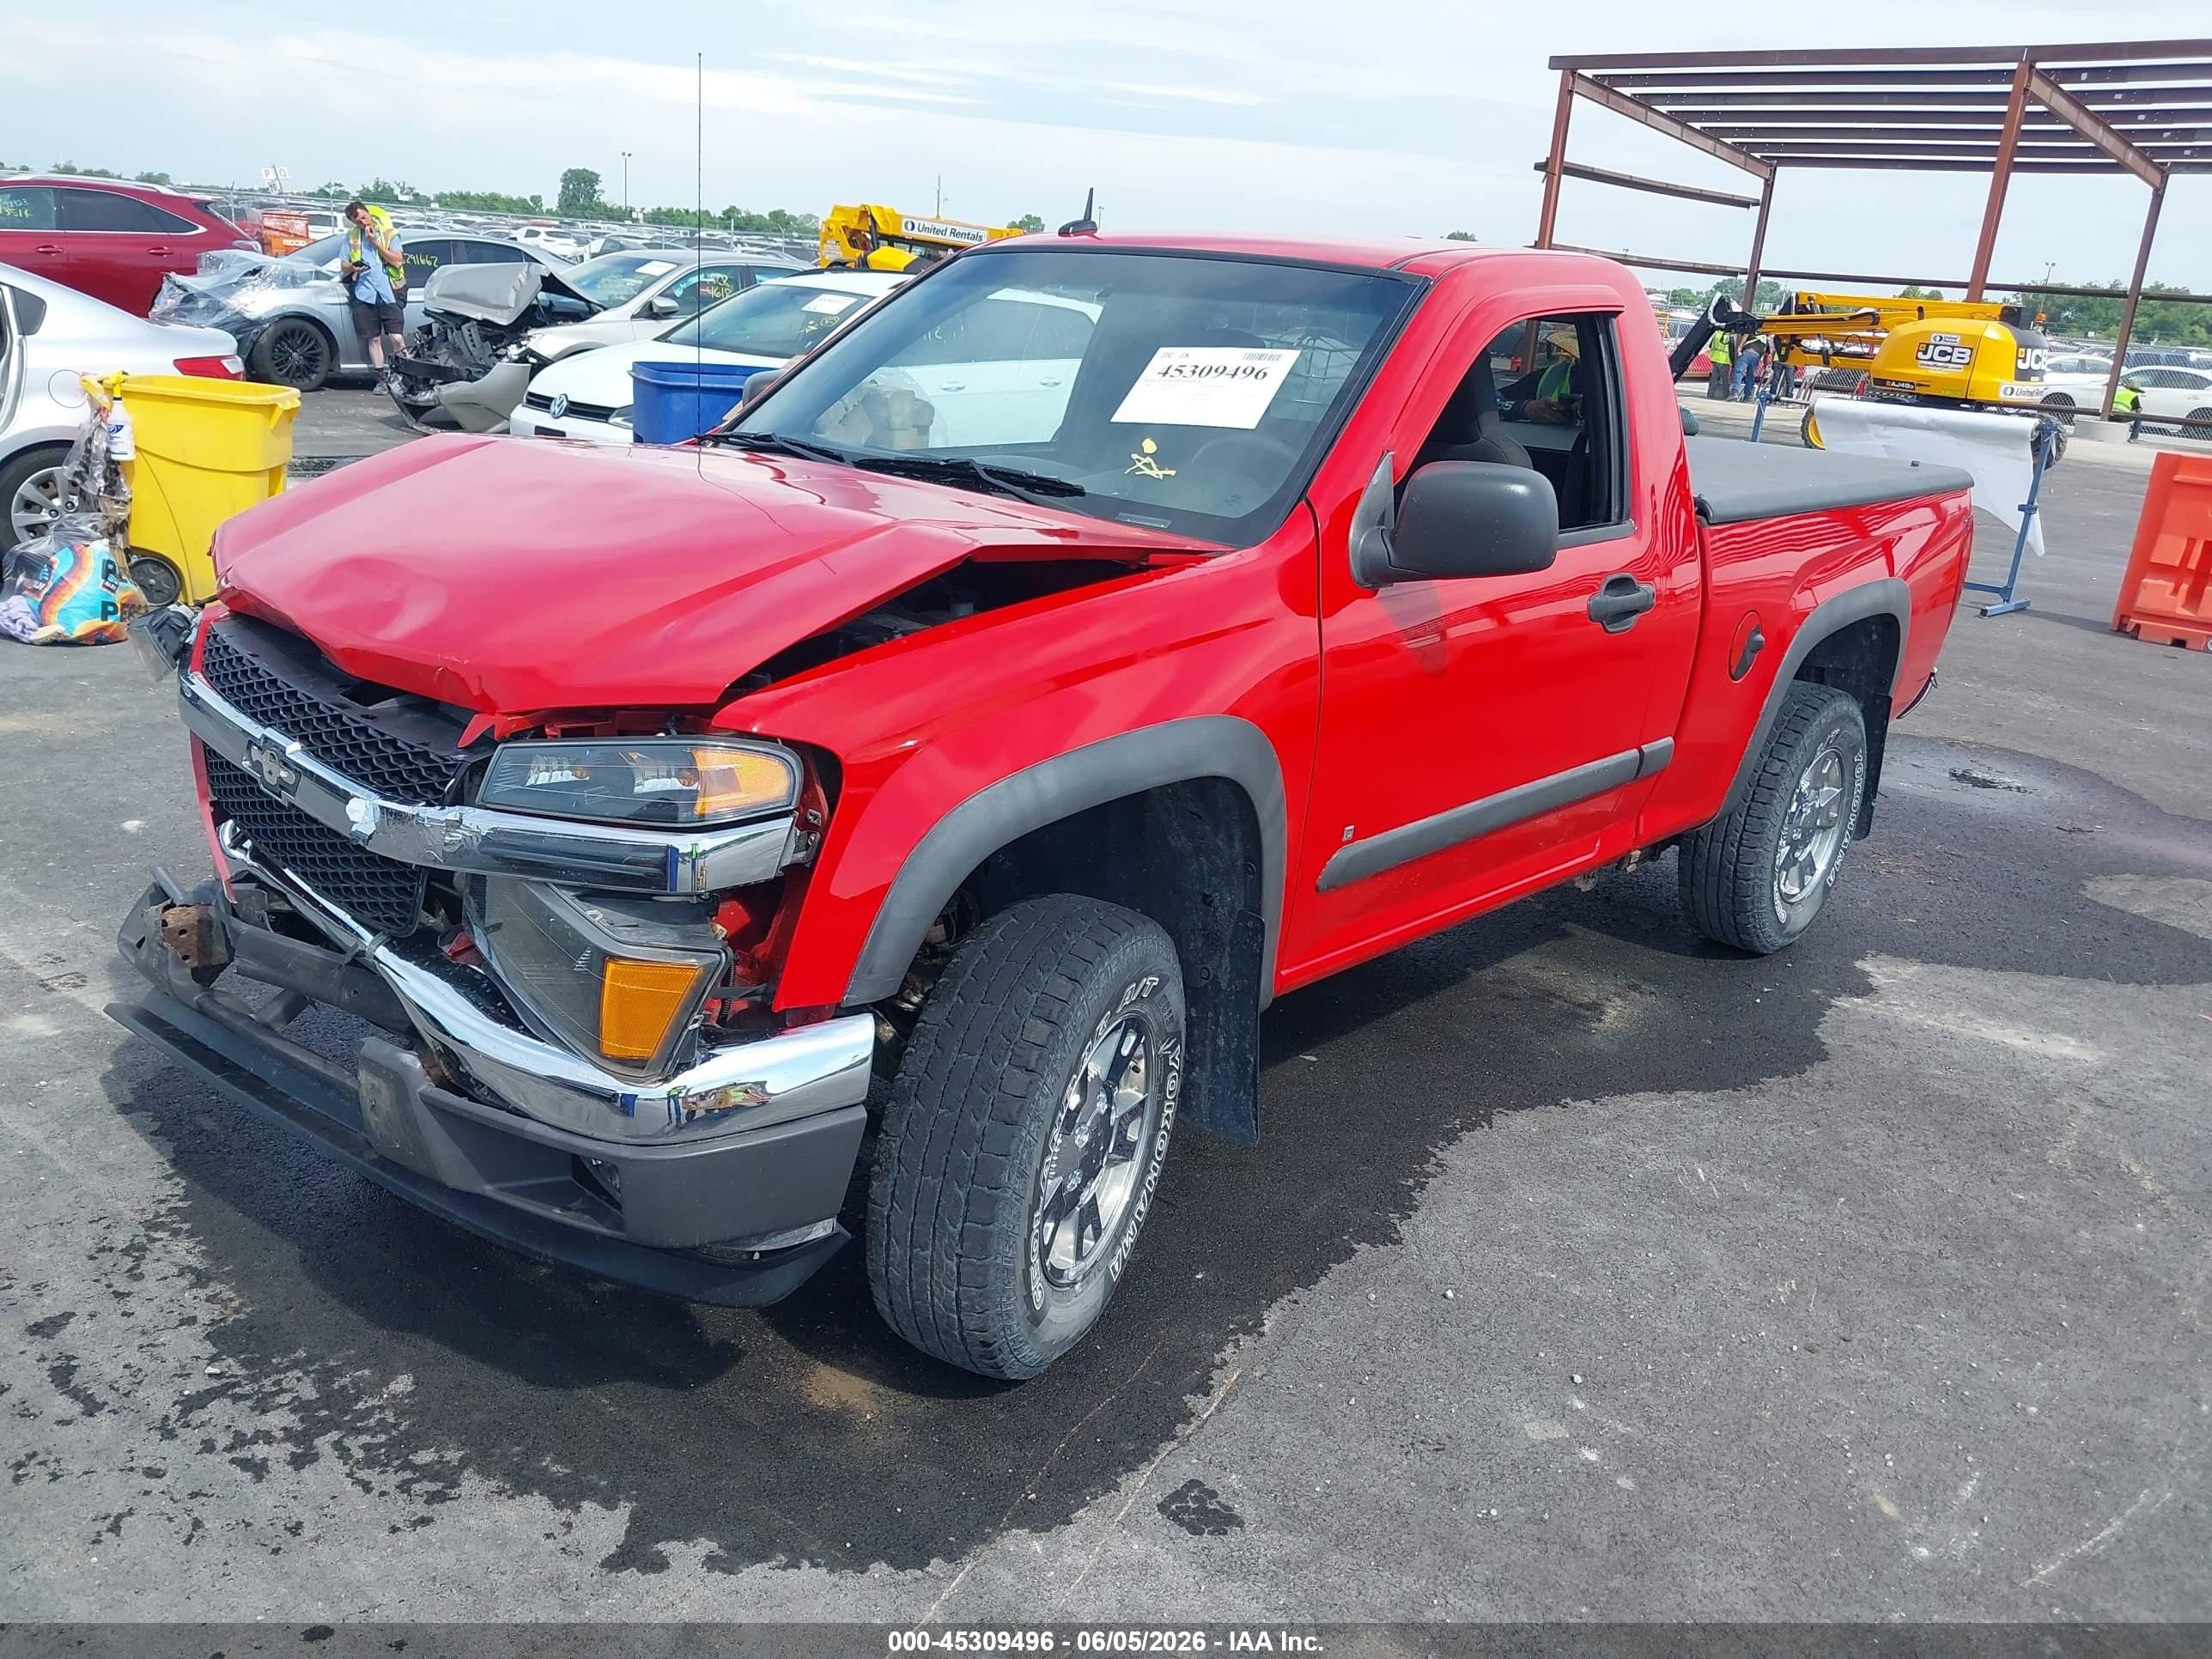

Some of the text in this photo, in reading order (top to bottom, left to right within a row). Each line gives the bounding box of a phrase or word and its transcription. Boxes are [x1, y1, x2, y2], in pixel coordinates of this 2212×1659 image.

[917, 222, 983, 242] United Rentals
[403, 252, 438, 267] 291662
[1917, 344, 1972, 364] JCB
[1157, 364, 1271, 380] 45309496
[1826, 748, 1863, 887] YOKOHAMA
[1109, 1043, 1181, 1282] YOKOHAMA
